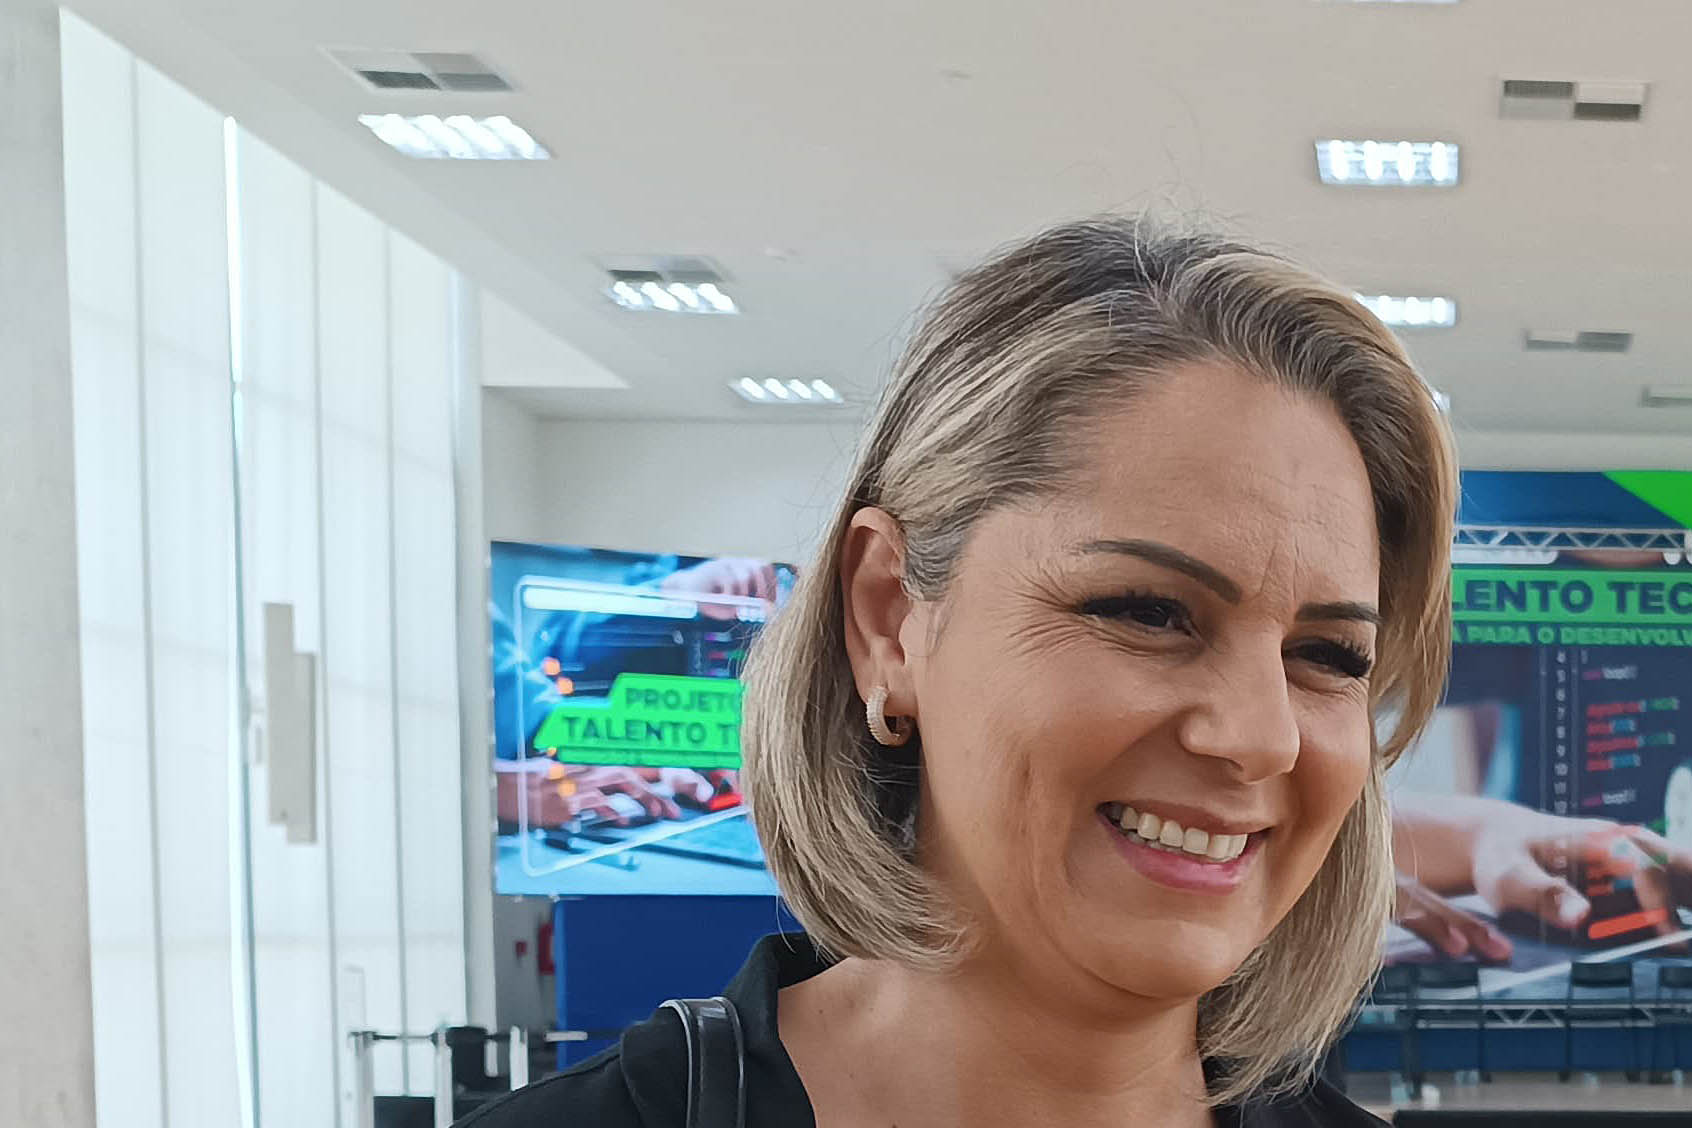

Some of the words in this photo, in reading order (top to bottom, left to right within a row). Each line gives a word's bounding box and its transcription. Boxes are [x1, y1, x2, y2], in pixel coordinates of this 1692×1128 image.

[1452, 580, 1594, 613] ENTO
[1466, 625, 1533, 643] PARA
[1538, 626, 1554, 644] O
[563, 716, 708, 744] TALENTO
